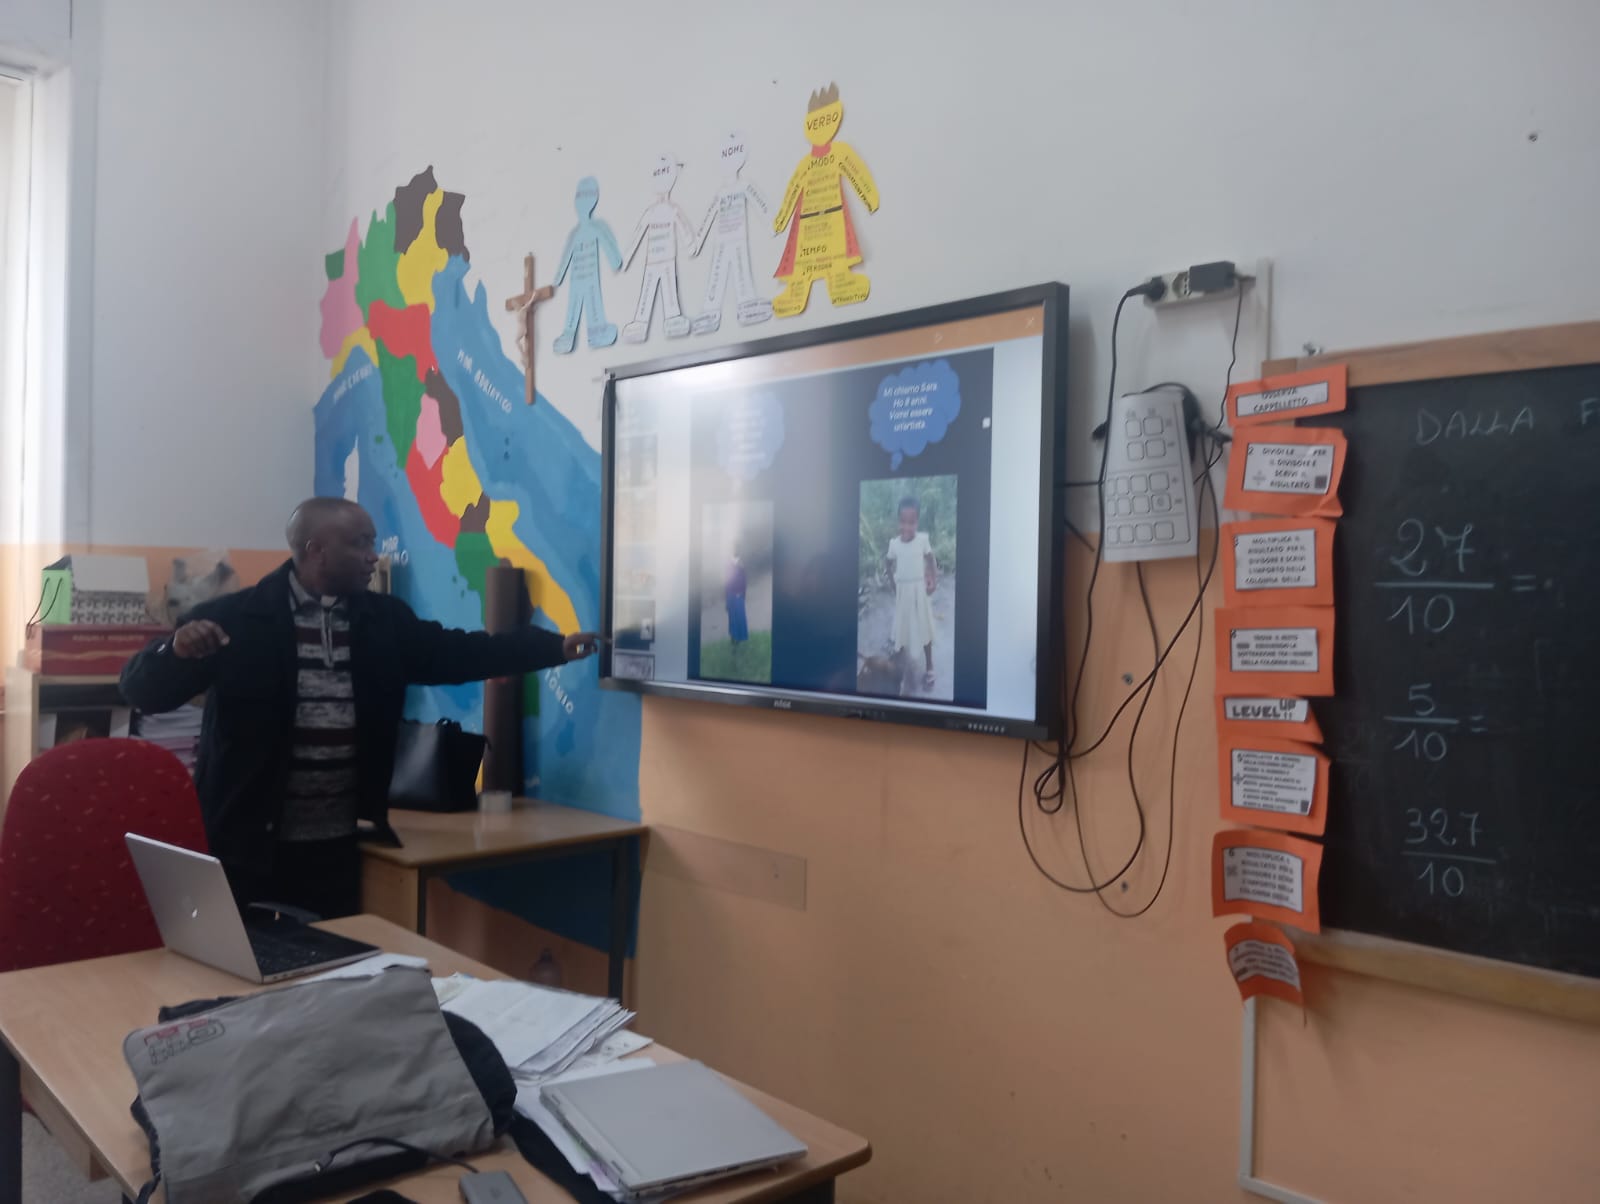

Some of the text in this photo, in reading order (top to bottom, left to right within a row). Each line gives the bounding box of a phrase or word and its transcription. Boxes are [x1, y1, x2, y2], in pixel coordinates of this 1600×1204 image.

[806, 111, 839, 131] VERBO
[801, 245, 827, 257] TEMPO
[1253, 398, 1309, 413] CAPPELLETTO
[1416, 406, 1534, 445] DALLA
[1390, 518, 1476, 577] 27
[1387, 593, 1455, 635] 10
[1232, 699, 1297, 718] LEVEL UP
[1408, 683, 1436, 717] 5
[1394, 728, 1448, 761] 10
[1418, 861, 1465, 897] 10
